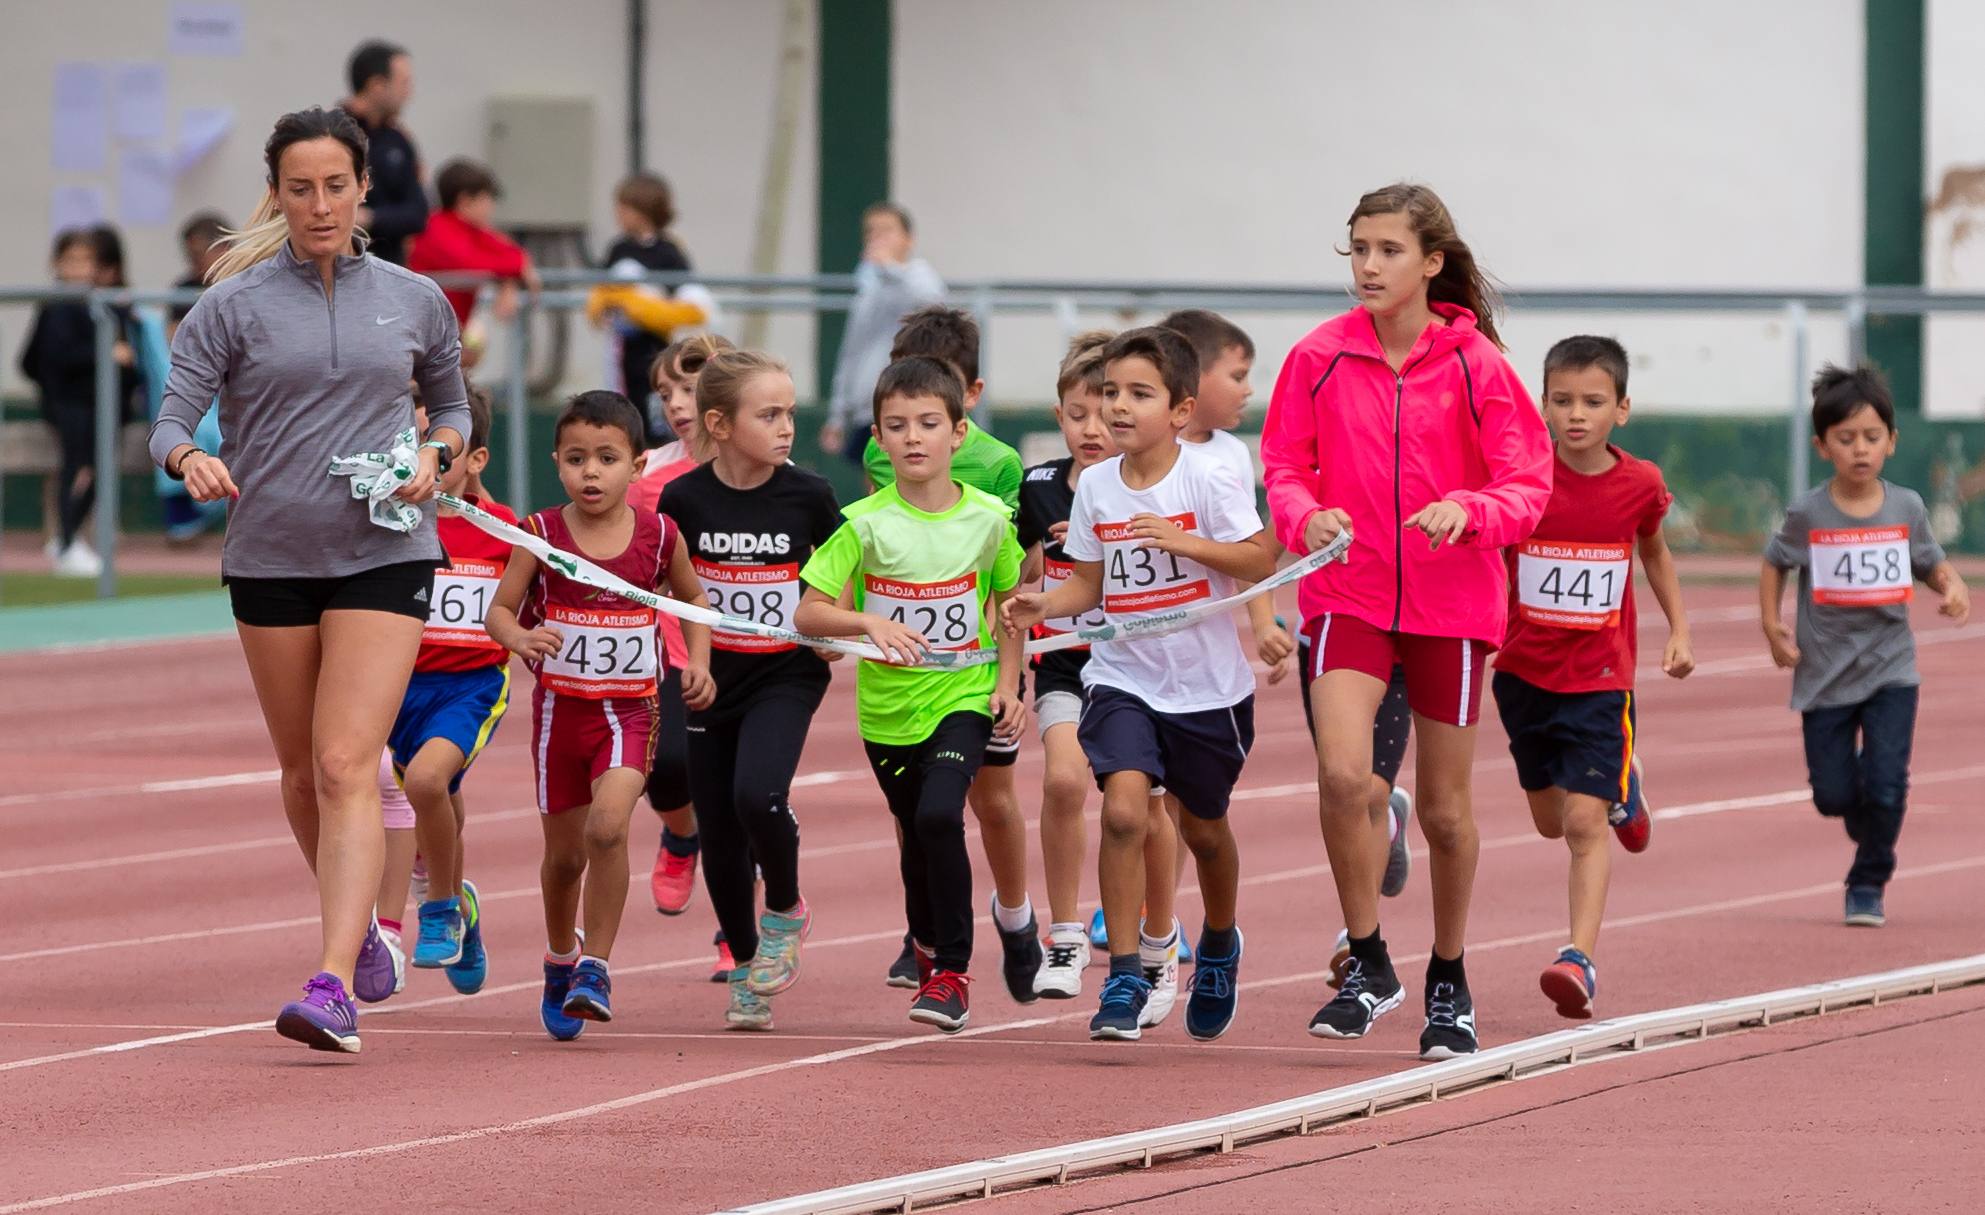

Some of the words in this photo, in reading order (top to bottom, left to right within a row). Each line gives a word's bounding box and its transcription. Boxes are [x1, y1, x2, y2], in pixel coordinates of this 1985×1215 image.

[1026, 467, 1057, 481] NIKE
[698, 532, 790, 554] ADIDAS
[1528, 544, 1539, 554] LA
[1542, 546, 1573, 558] RIOJA
[1576, 548, 1625, 559] ATLETISMO
[451, 563, 496, 576] TLETISMO
[696, 564, 705, 574] LA
[705, 567, 733, 581] RIOJA
[735, 570, 789, 582] ATLETISMO
[1111, 547, 1187, 588] 431
[1834, 548, 1901, 584] 458
[872, 581, 884, 593] LA
[886, 585, 916, 598] RIOJA
[918, 581, 969, 598] ATLETISMO
[1538, 567, 1613, 606] 441
[429, 585, 485, 623] 61
[707, 587, 785, 628] 398
[555, 610, 567, 620] LA
[568, 612, 599, 625] RIOJA
[602, 614, 649, 626] ATLETISMO
[564, 635, 643, 675] 432
[937, 750, 965, 762] KIPSTA
